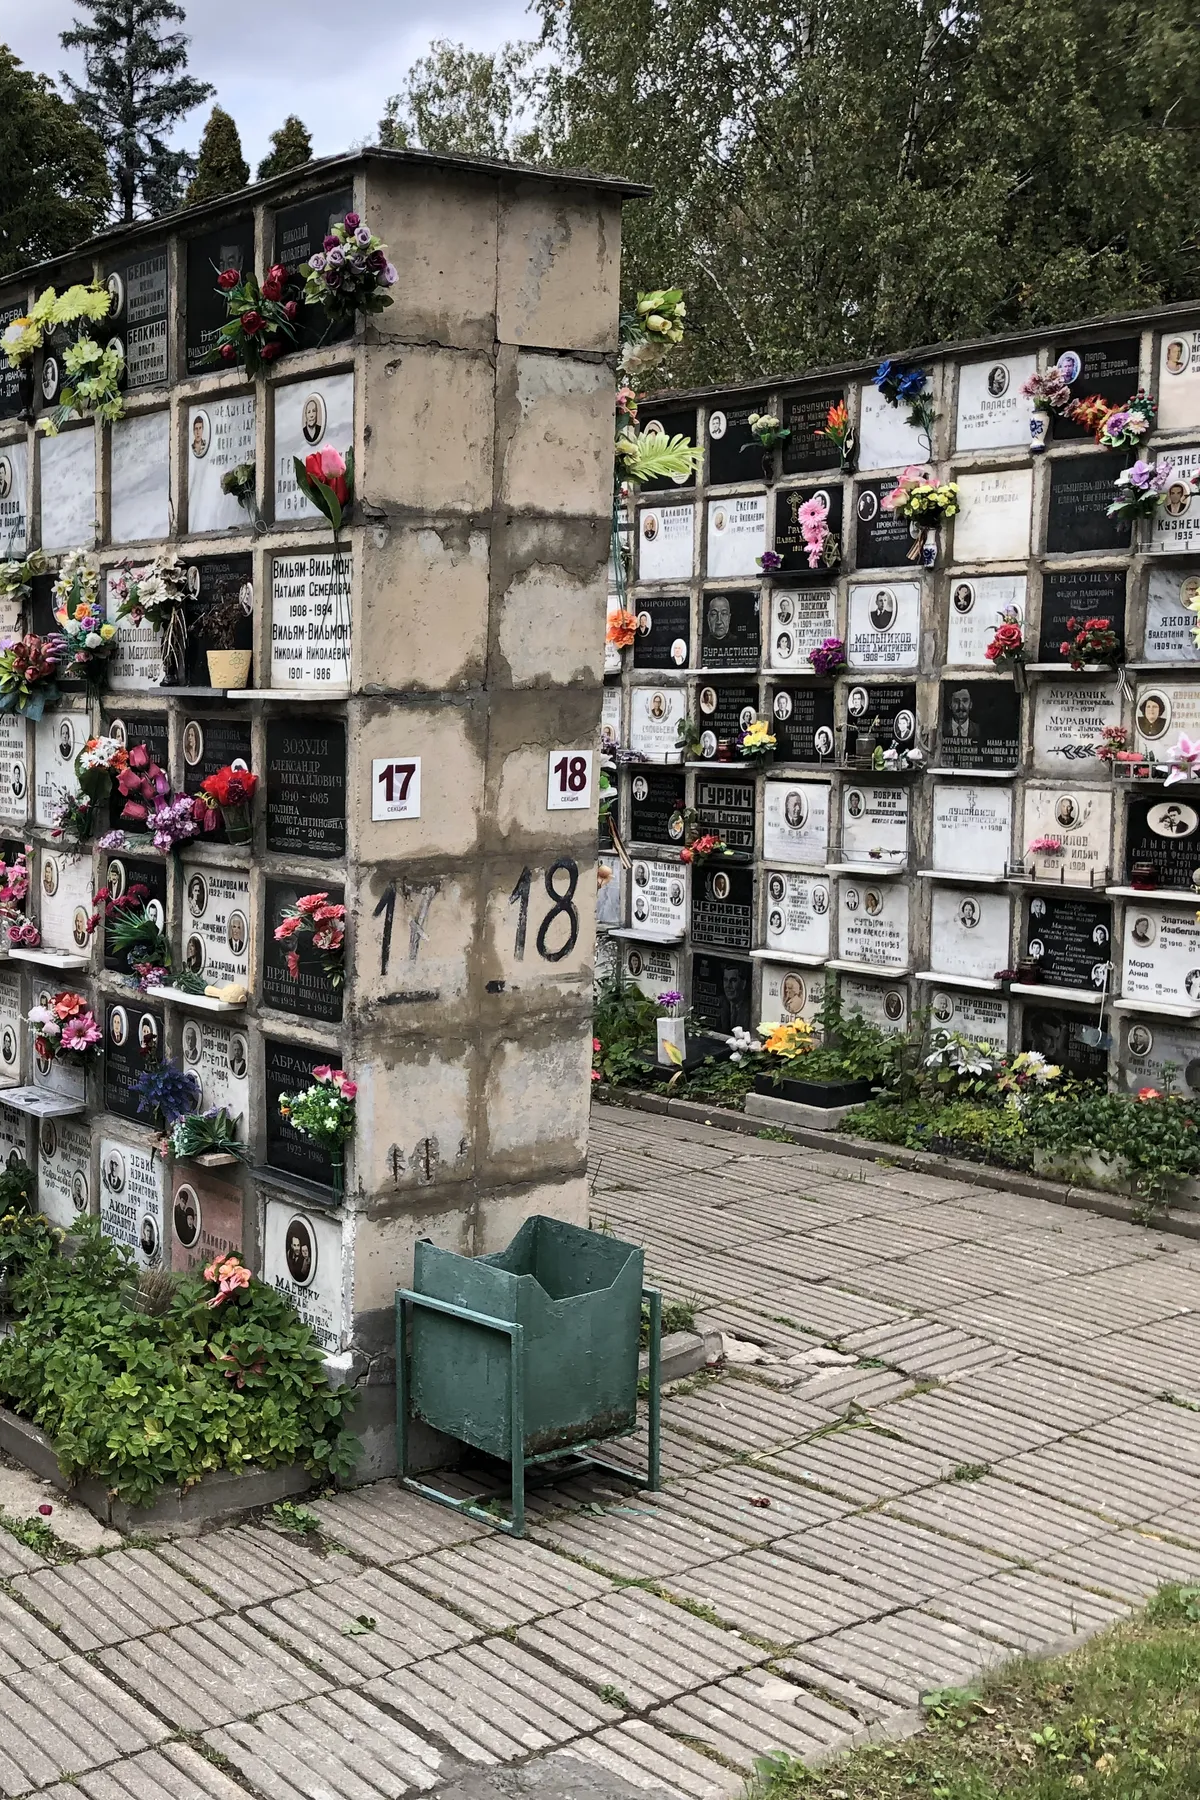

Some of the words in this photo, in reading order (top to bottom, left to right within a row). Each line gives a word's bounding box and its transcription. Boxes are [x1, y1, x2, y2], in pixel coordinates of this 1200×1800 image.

[128, 321, 166, 345] БЕЛКИНА
[1175, 531, 1193, 540] 1935
[1051, 573, 1122, 583] ЕВДОЩУК
[274, 584, 305, 598] НАТАЛИЯ
[290, 604, 307, 617] 1908
[314, 603, 333, 616] 1984
[117, 627, 157, 642] СОКОЛОВА
[855, 632, 911, 643] МЫЛЬНИКОВ
[274, 647, 303, 660] НИКОЛАЙ
[306, 646, 351, 660] НИКОЛАЕВИЧ
[703, 646, 758, 657] БУРДАСТИКОВ
[873, 643, 916, 653] ДМИТРИЕВИЧ
[289, 668, 303, 679] 1901
[314, 668, 331, 680] 1986
[1050, 690, 1107, 699] МУРАВЧИК
[1050, 716, 1105, 726] МУРАВЧИК
[283, 739, 329, 755] ЗОЗУЛЯ
[270, 760, 321, 773] АЛЕКСАНДР
[280, 773, 342, 787] МИХАЙЛОВИЧ
[554, 757, 587, 792] 18
[378, 764, 416, 801] 17
[281, 791, 299, 801] 1910
[309, 793, 329, 804] 1985
[699, 783, 753, 806] ГУРВИЧ
[269, 804, 299, 815] ПОЛИНА
[275, 815, 344, 830] КОНСТАНТИНОВНА
[285, 827, 300, 836] 1917
[308, 830, 325, 838] 2010
[1071, 849, 1099, 860] ИЛЬИЧ
[209, 877, 237, 890] ЗАХАРОВА
[510, 858, 580, 962] 18
[694, 902, 749, 917] ЧЕРНЯЕВ
[694, 913, 749, 926] ГЕННАДИЙ
[1161, 916, 1195, 926] Златина
[693, 925, 749, 936] ИВАНОВИЧ
[1129, 960, 1154, 969] Мороз
[1129, 969, 1149, 978] Анна
[267, 1070, 295, 1085] ТАТЬЯНА
[279, 1127, 298, 1141] ИННА
